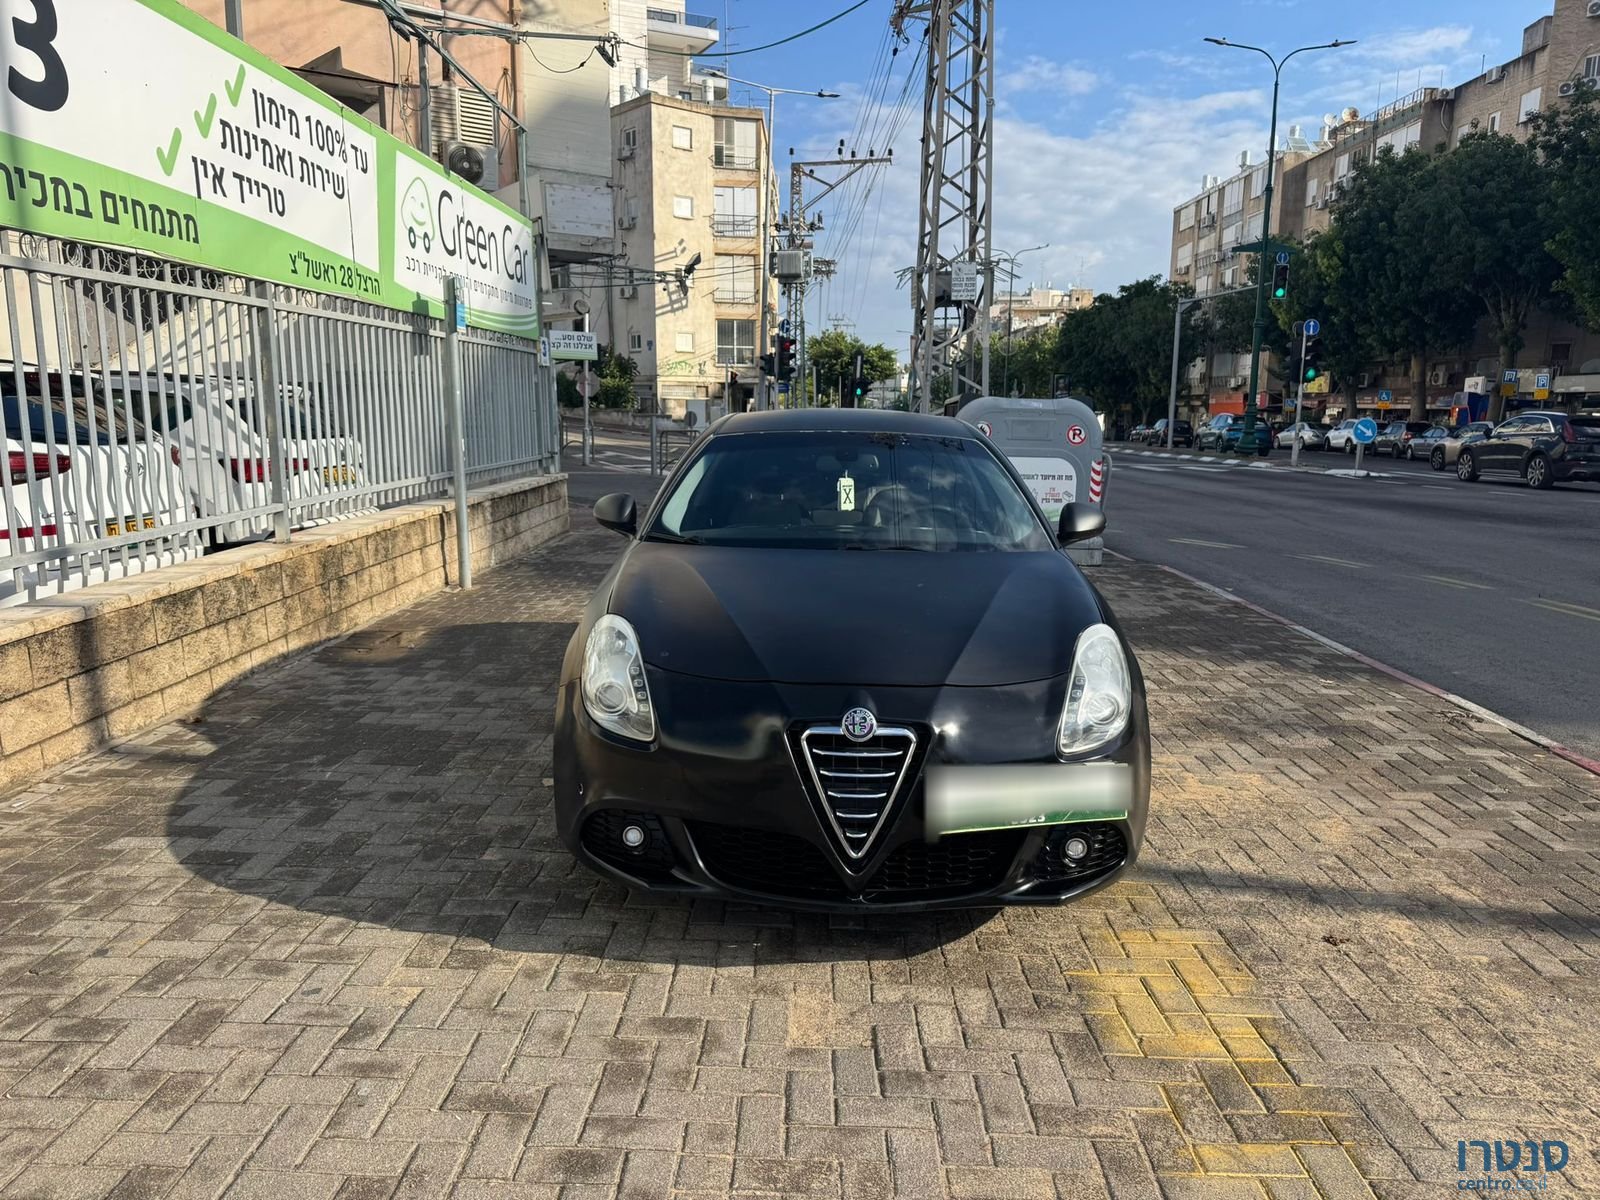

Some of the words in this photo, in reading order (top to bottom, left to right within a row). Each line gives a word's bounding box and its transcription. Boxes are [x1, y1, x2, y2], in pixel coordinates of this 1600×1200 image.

[252, 87, 300, 140] מימון
[219, 118, 294, 179] ואמינות
[305, 114, 348, 164] 100%
[350, 143, 369, 174] עד
[191, 155, 227, 200] אין
[232, 171, 286, 217] טרייד
[298, 155, 345, 200] שירות
[100, 189, 200, 244] מתמחים
[438, 190, 499, 275] Green
[503, 224, 528, 286] Car
[339, 264, 354, 289] 28
[356, 267, 381, 296] הרצל
[405, 255, 421, 274] רכב
[573, 342, 594, 350] אצלנו
[576, 333, 593, 342] שלם
